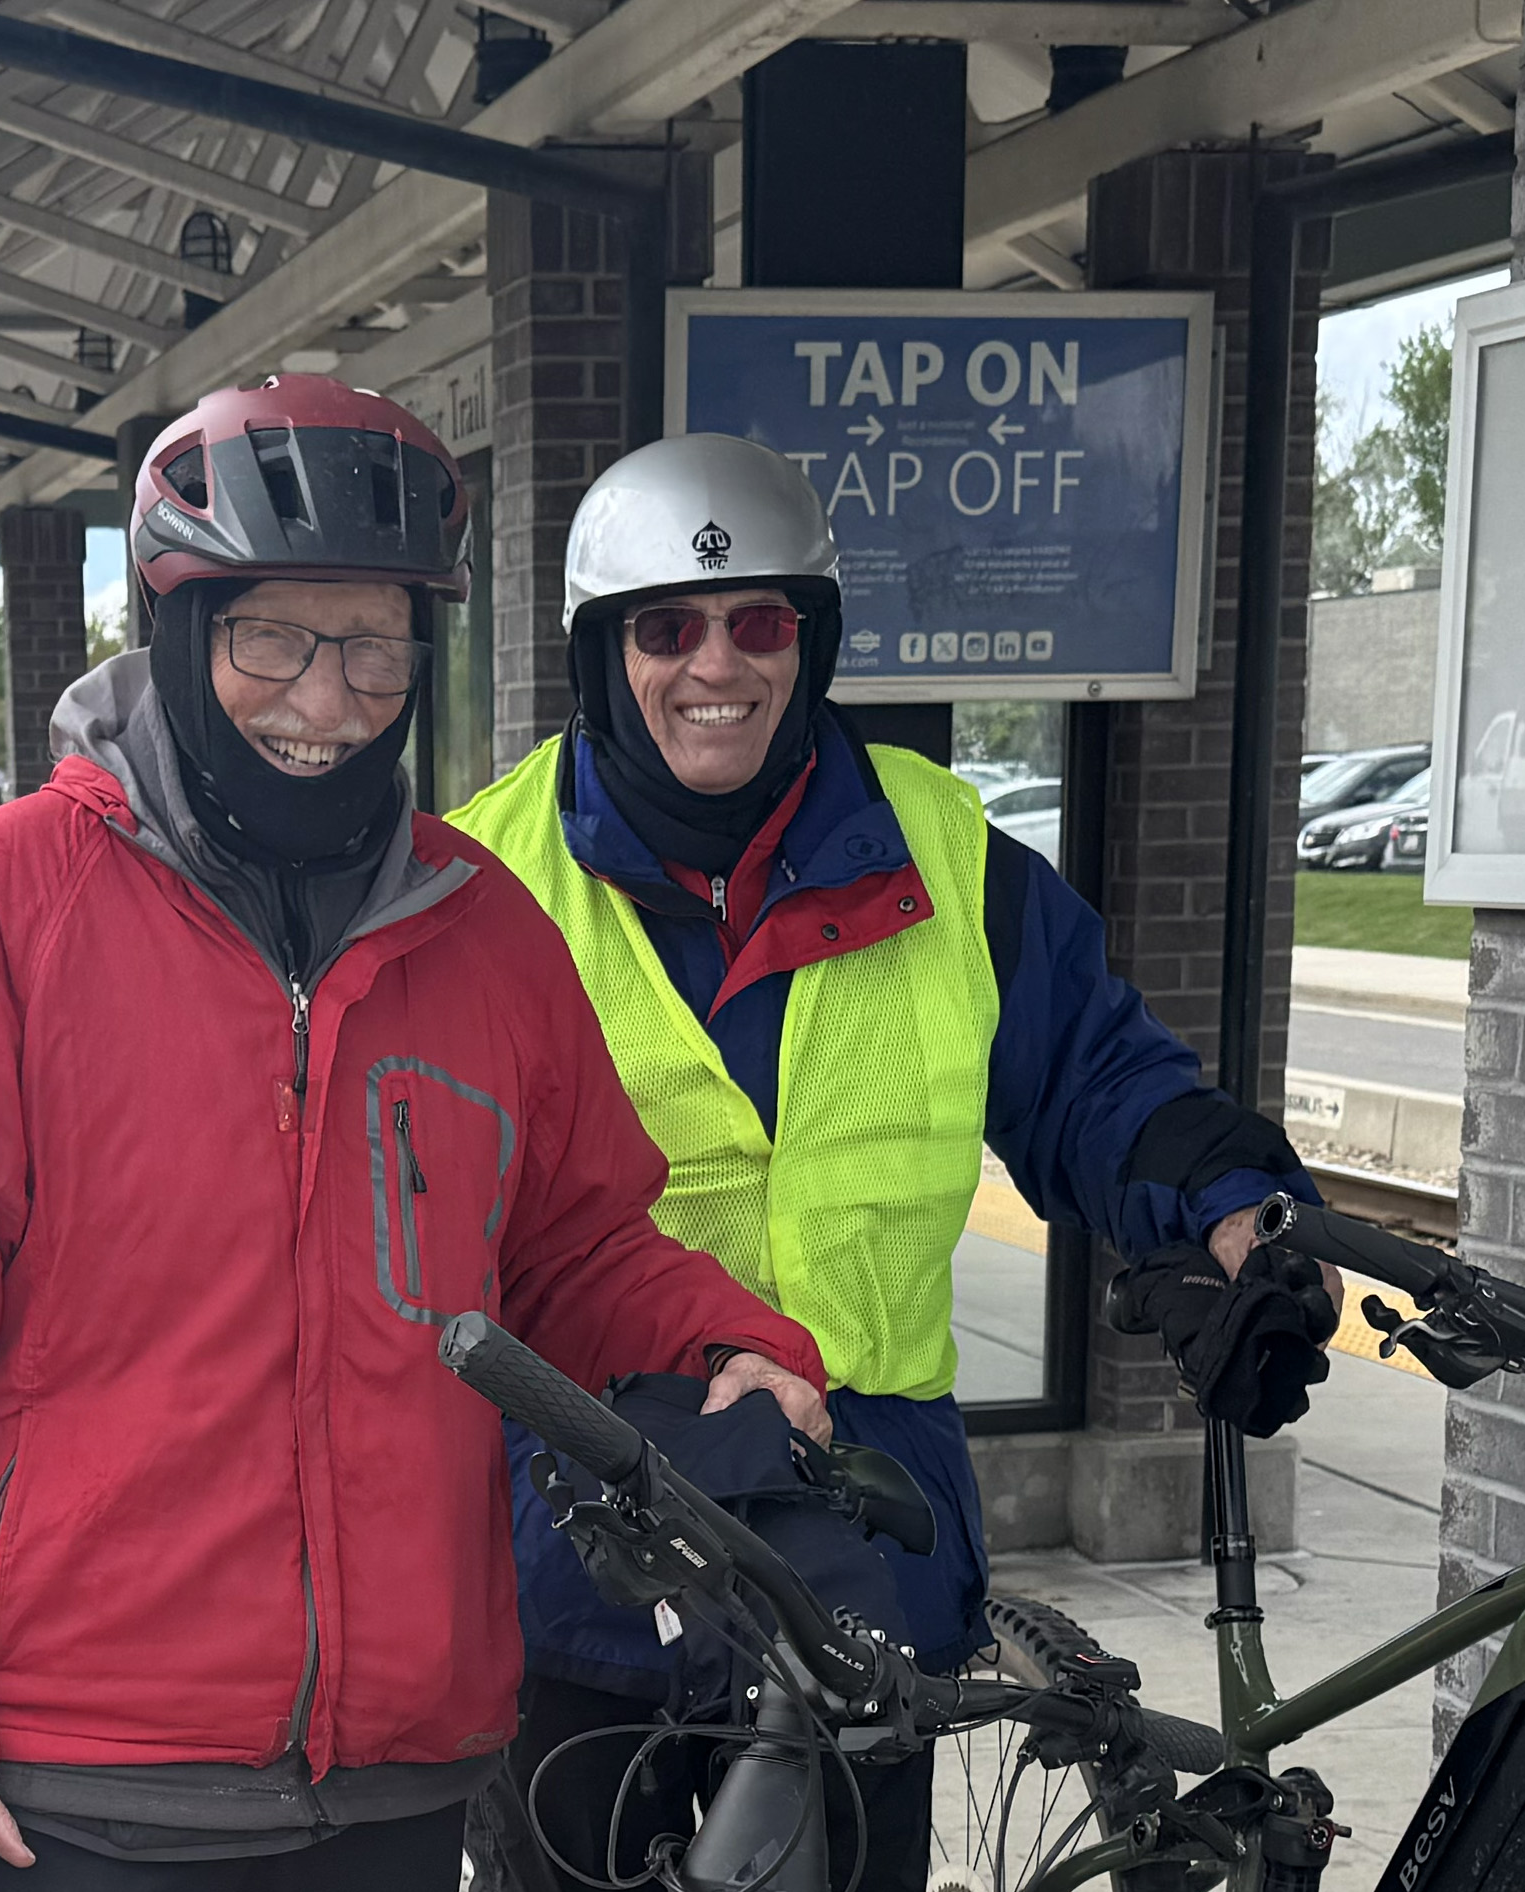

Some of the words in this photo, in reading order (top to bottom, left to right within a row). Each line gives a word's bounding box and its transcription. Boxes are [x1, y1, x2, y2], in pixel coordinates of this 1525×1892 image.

[448, 364, 487, 441] Trail
[794, 341, 944, 407] TAP
[965, 341, 1080, 407] ON
[785, 451, 923, 517] TAP
[948, 450, 1085, 517] OFF
